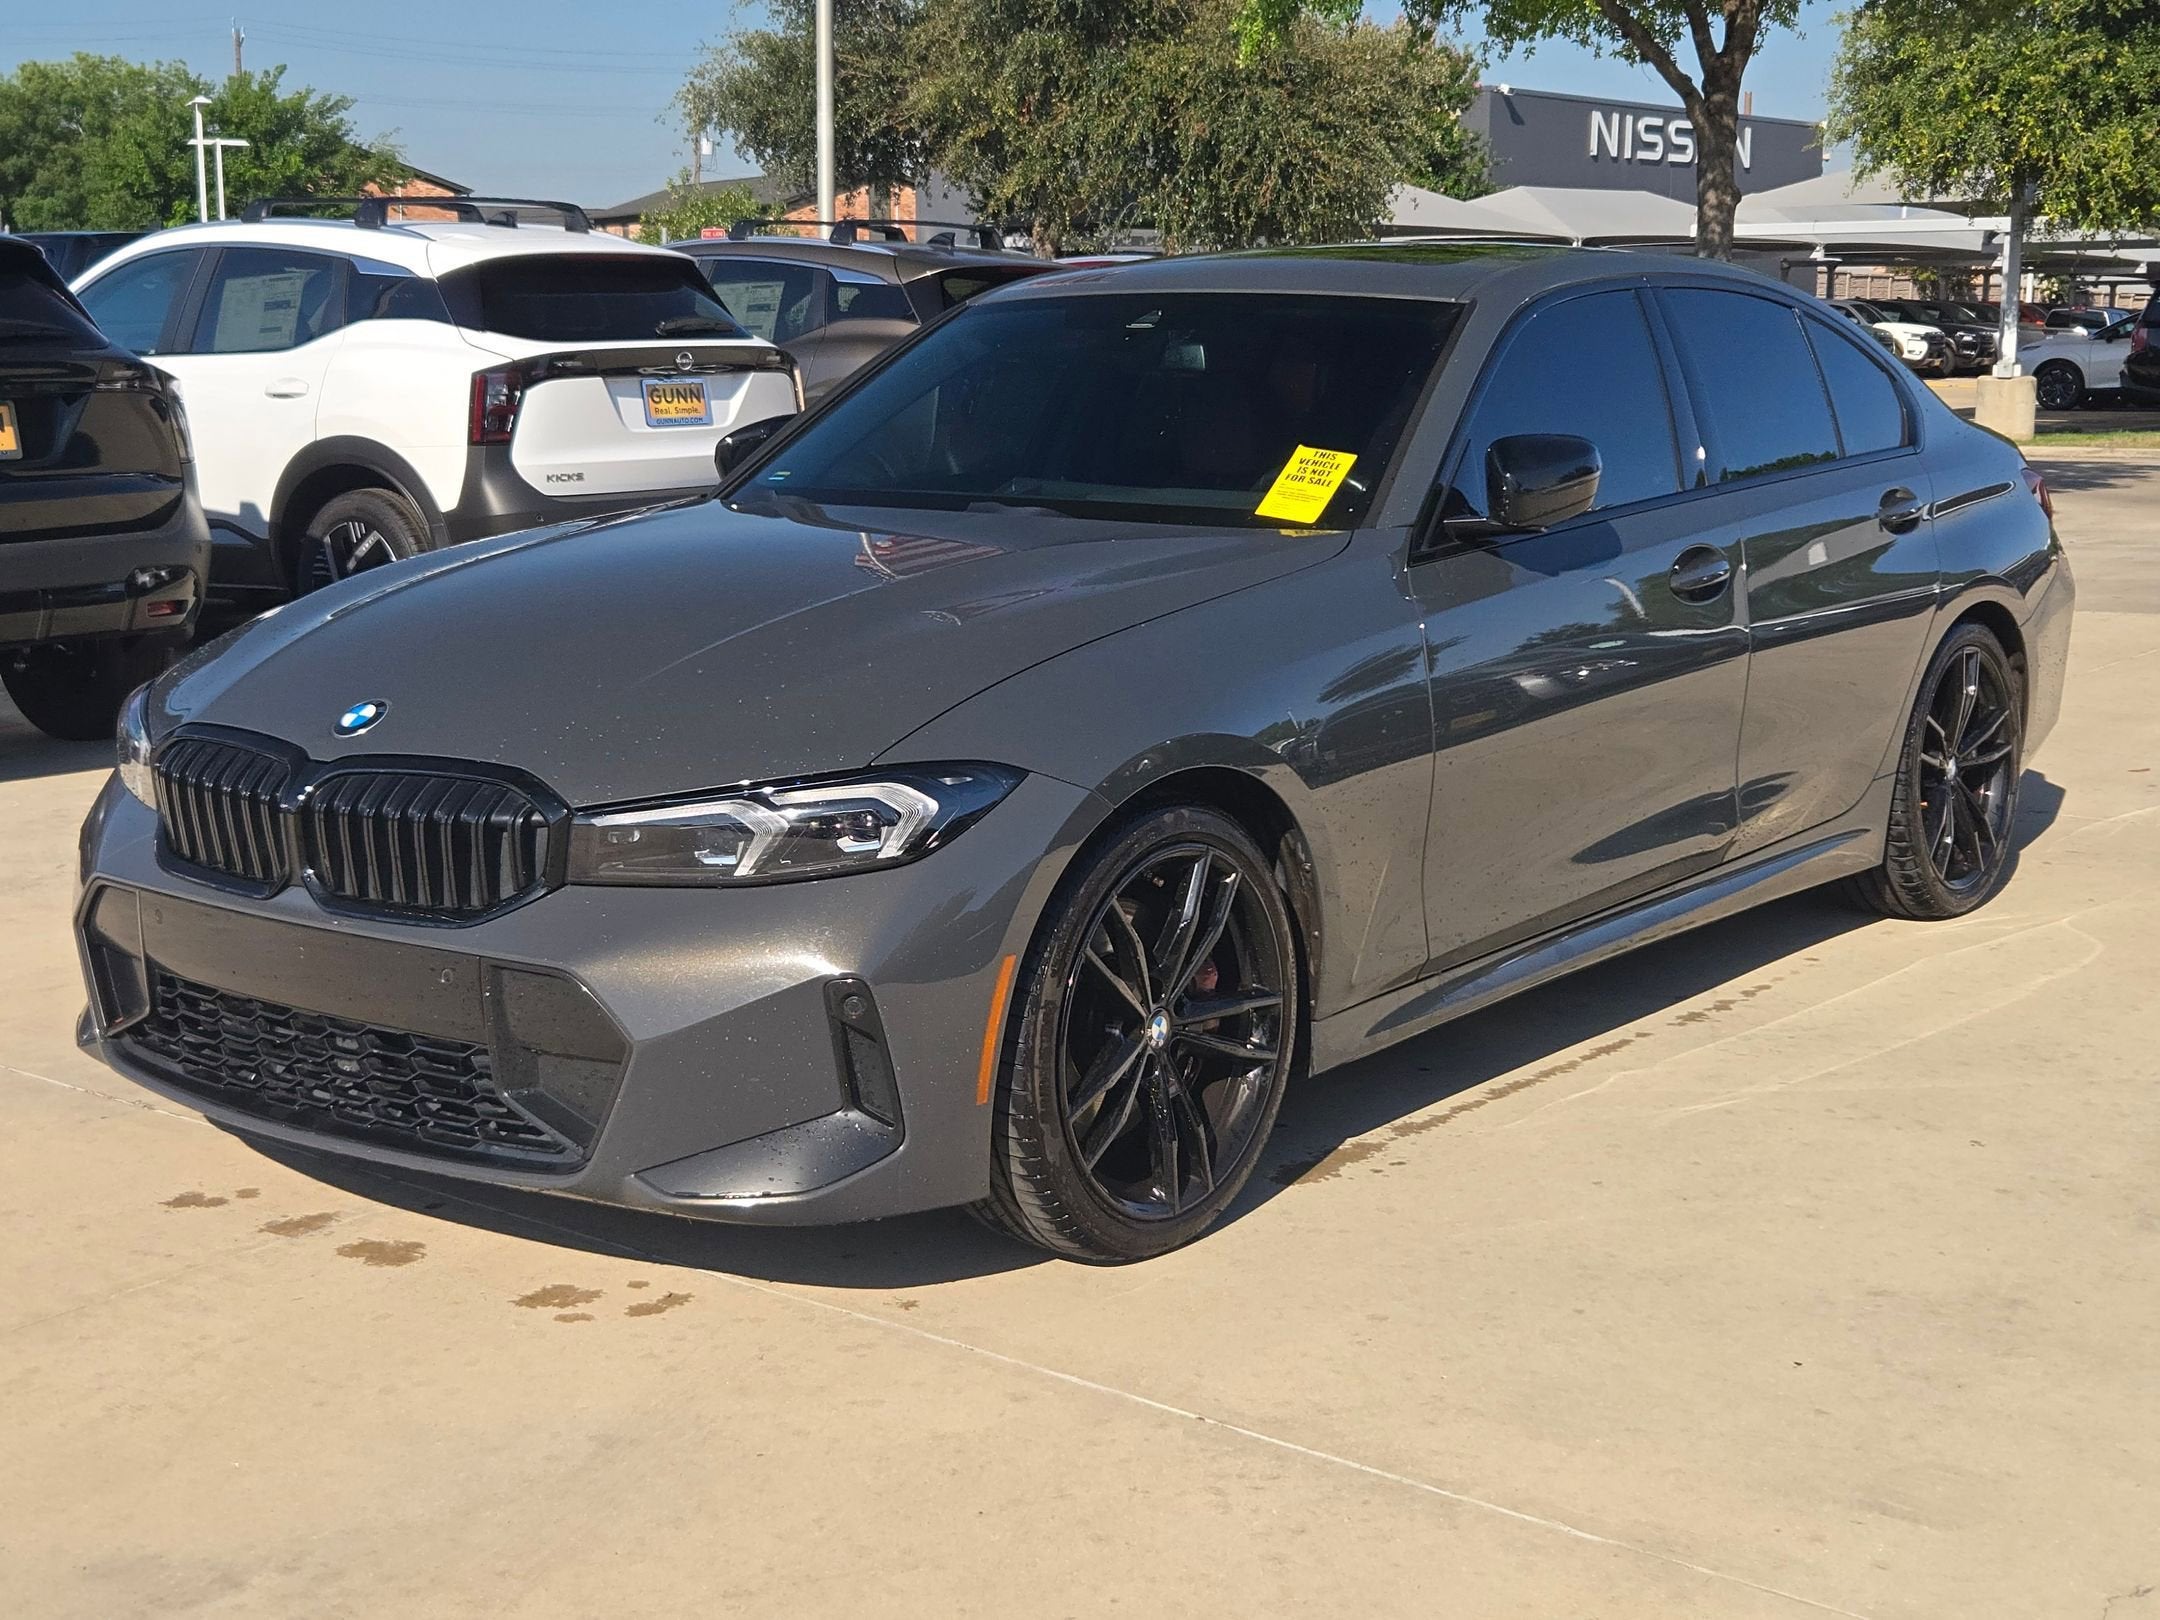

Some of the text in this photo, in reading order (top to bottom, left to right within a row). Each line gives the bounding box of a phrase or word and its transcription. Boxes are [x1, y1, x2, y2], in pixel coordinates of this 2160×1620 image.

[1589, 110, 1752, 169] NISSN
[650, 387, 702, 404] GUNN
[654, 406, 701, 415] Real. Simple.
[1313, 451, 1337, 460] THIS
[1299, 458, 1340, 470] VEHICLE
[546, 472, 585, 483] KICKS
[1297, 467, 1332, 477] IS NOT
[1284, 474, 1332, 487] FOR SALE
